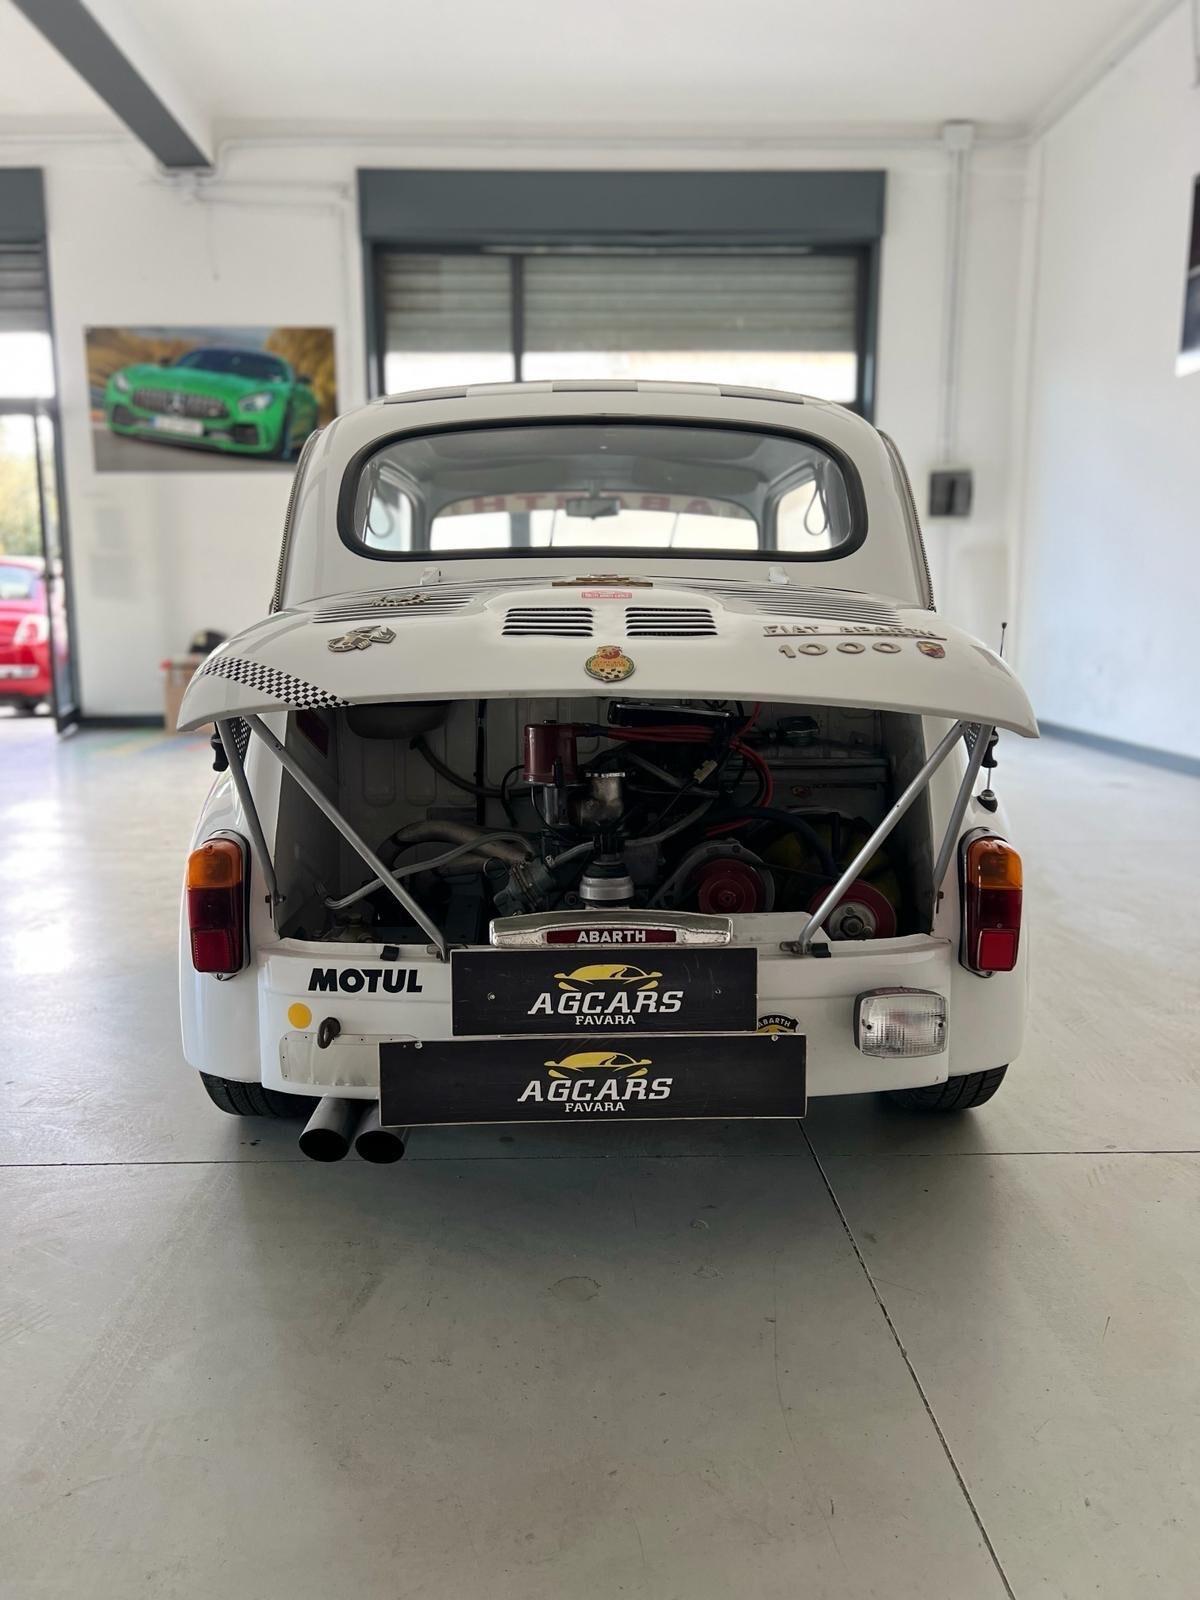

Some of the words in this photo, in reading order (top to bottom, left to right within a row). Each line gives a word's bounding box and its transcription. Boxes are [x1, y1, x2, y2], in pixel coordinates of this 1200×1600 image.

[763, 625, 819, 635] FIAT
[778, 641, 902, 658] 1000
[577, 930, 646, 943] ABARTH
[308, 968, 423, 993] MOTUL
[527, 990, 684, 1015] AGCARS
[575, 1015, 636, 1025] FAVARA
[517, 1077, 673, 1102] AGCARS
[565, 1101, 626, 1112] FAVARA
